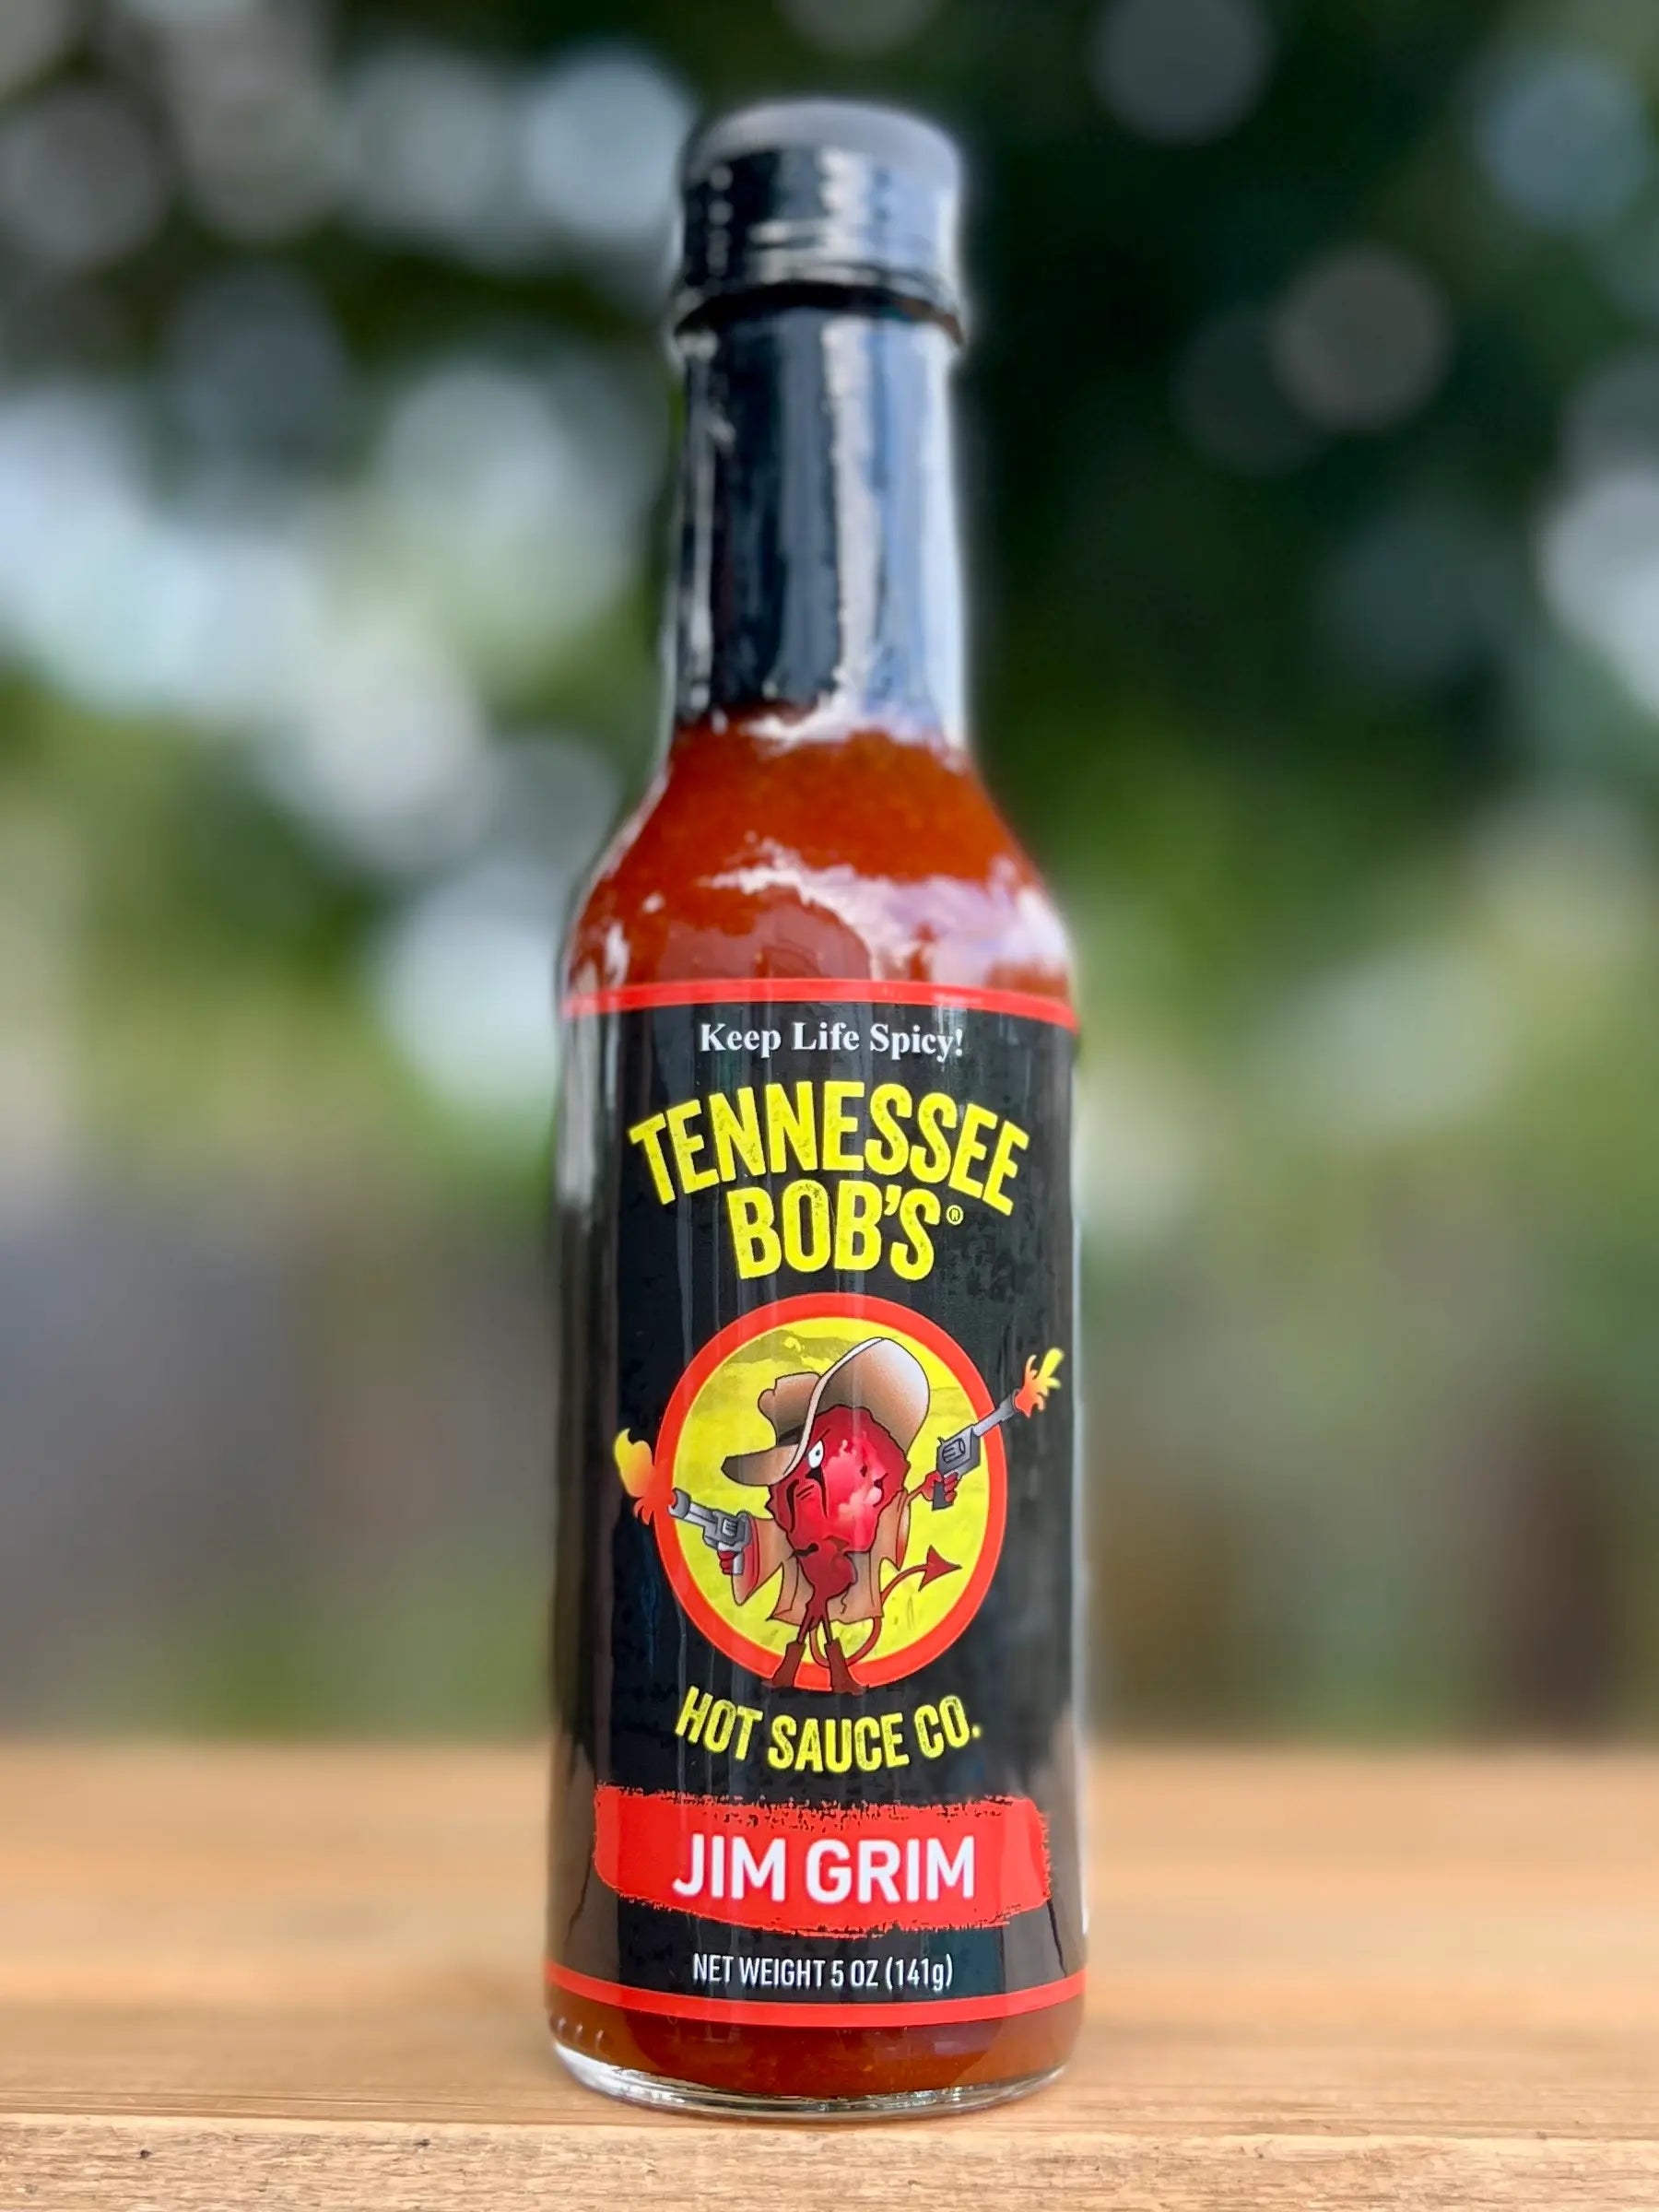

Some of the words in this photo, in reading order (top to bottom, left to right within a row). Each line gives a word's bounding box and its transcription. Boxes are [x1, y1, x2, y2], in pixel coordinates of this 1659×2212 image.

[700, 1022, 782, 1058] Keep
[793, 1021, 859, 1051] Life
[869, 1022, 964, 1062] Spicy!
[628, 1080, 1030, 1216] TENNESSEE
[675, 1686, 763, 1760] HOT
[768, 1712, 909, 1773] SAUCE
[914, 1695, 981, 1759] CO.
[672, 1834, 784, 1901] JIM
[806, 1835, 975, 1904] GRIM
[692, 1952, 734, 1985] NET
[738, 1956, 825, 1991] WEIGHT
[830, 1959, 844, 1990] 5
[851, 1958, 880, 1991] OZ
[885, 1952, 953, 1992] (141g)
